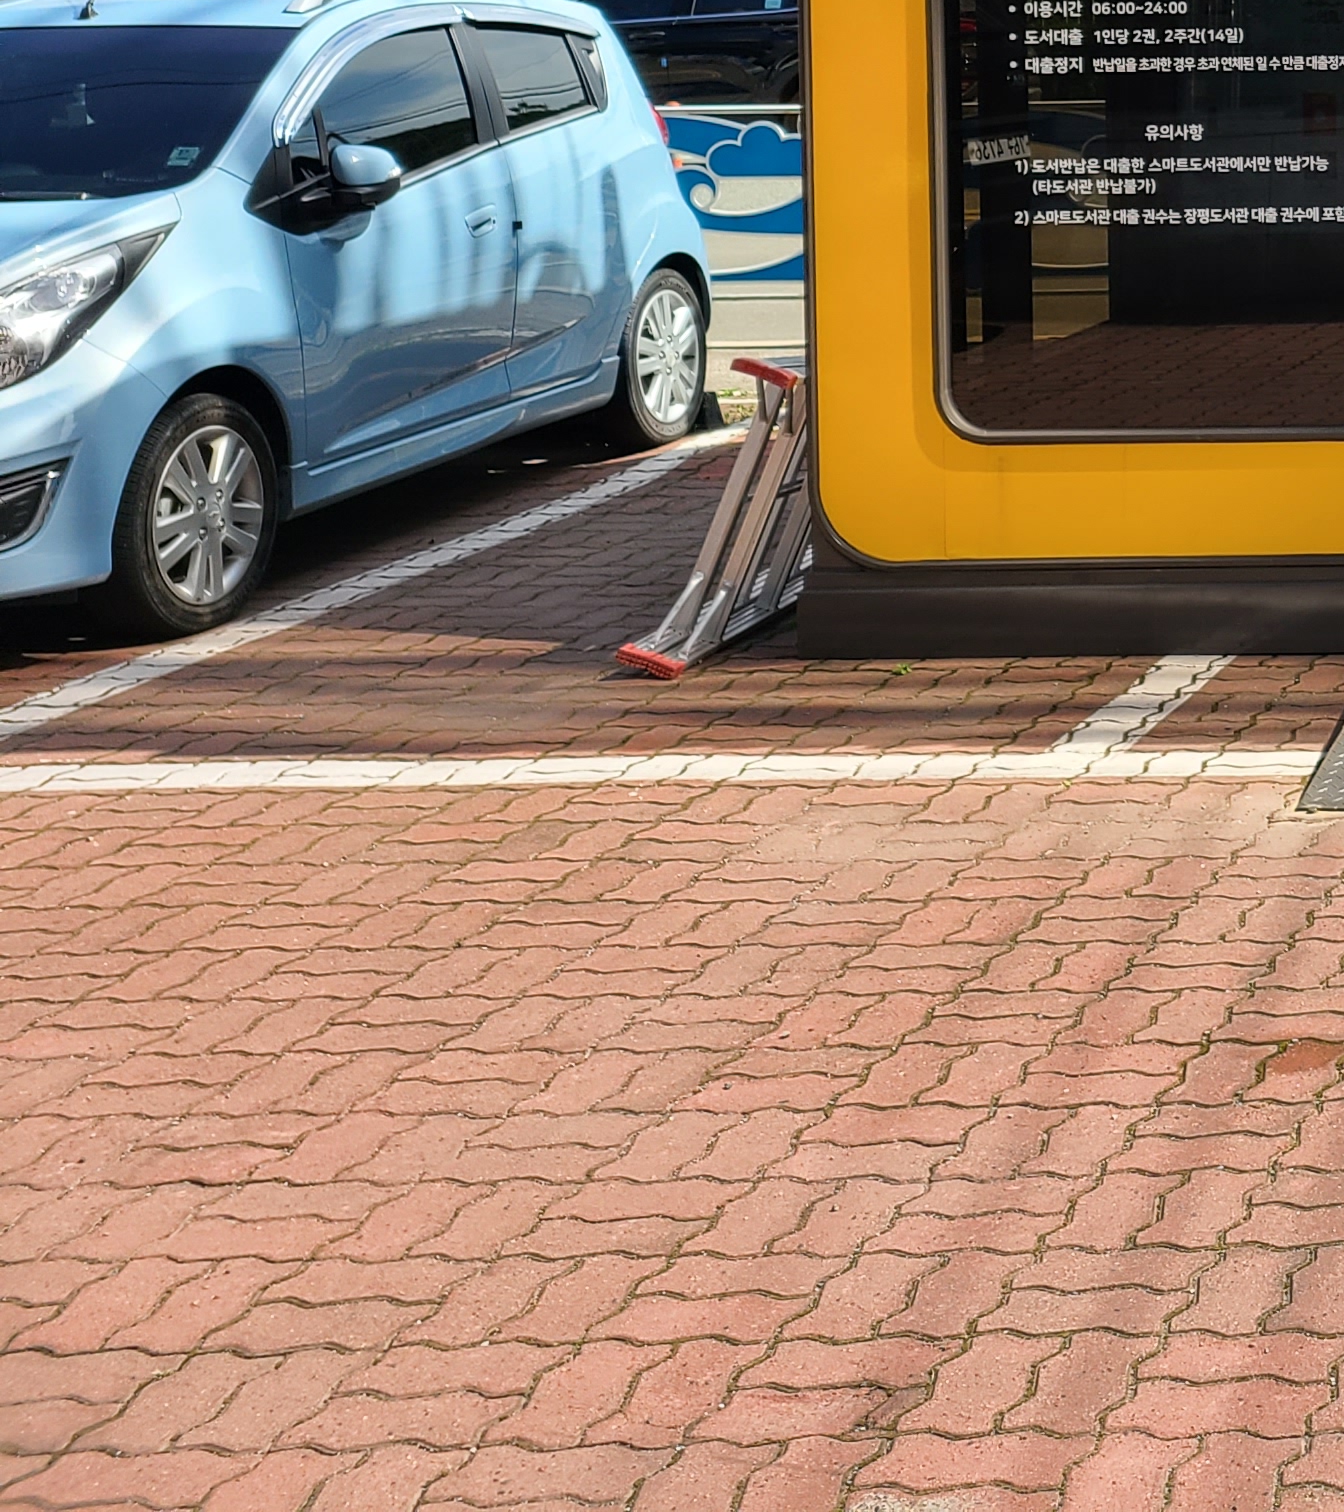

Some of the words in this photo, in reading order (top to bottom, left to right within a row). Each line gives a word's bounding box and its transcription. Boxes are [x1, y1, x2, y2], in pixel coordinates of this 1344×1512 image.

[1023, 0, 1083, 19] 이용시간
[1091, 1, 1188, 15] 06:00~24:00
[1024, 28, 1084, 46] 도서대출
[1093, 28, 1130, 45] 1인당
[1132, 28, 1160, 45] 2권,
[1164, 27, 1244, 44] 2주간(14일)
[1024, 56, 1083, 74] 대출정지
[1092, 57, 1138, 73] 반납일을
[1138, 56, 1173, 72] 초과한
[1173, 56, 1197, 73] 경우
[1144, 123, 1204, 142] 유의사항
[1014, 158, 1029, 175] 1)
[1031, 158, 1101, 175] 도서반납은
[1103, 157, 1146, 174] 대출한
[1147, 155, 1272, 173] 스마트도서관에서만
[1274, 155, 1330, 172] 반납가능
[1032, 178, 1094, 198] (타도서관
[1095, 178, 1156, 195] 반납불가)
[1014, 210, 1029, 226] 2)
[1032, 209, 1112, 226] 스마트도서관
[1113, 208, 1141, 225] 대출
[1141, 208, 1182, 225] 권수는
[1183, 207, 1250, 225] 장평도서관
[1251, 206, 1279, 224] 대출
[1279, 206, 1320, 223] 권수에
